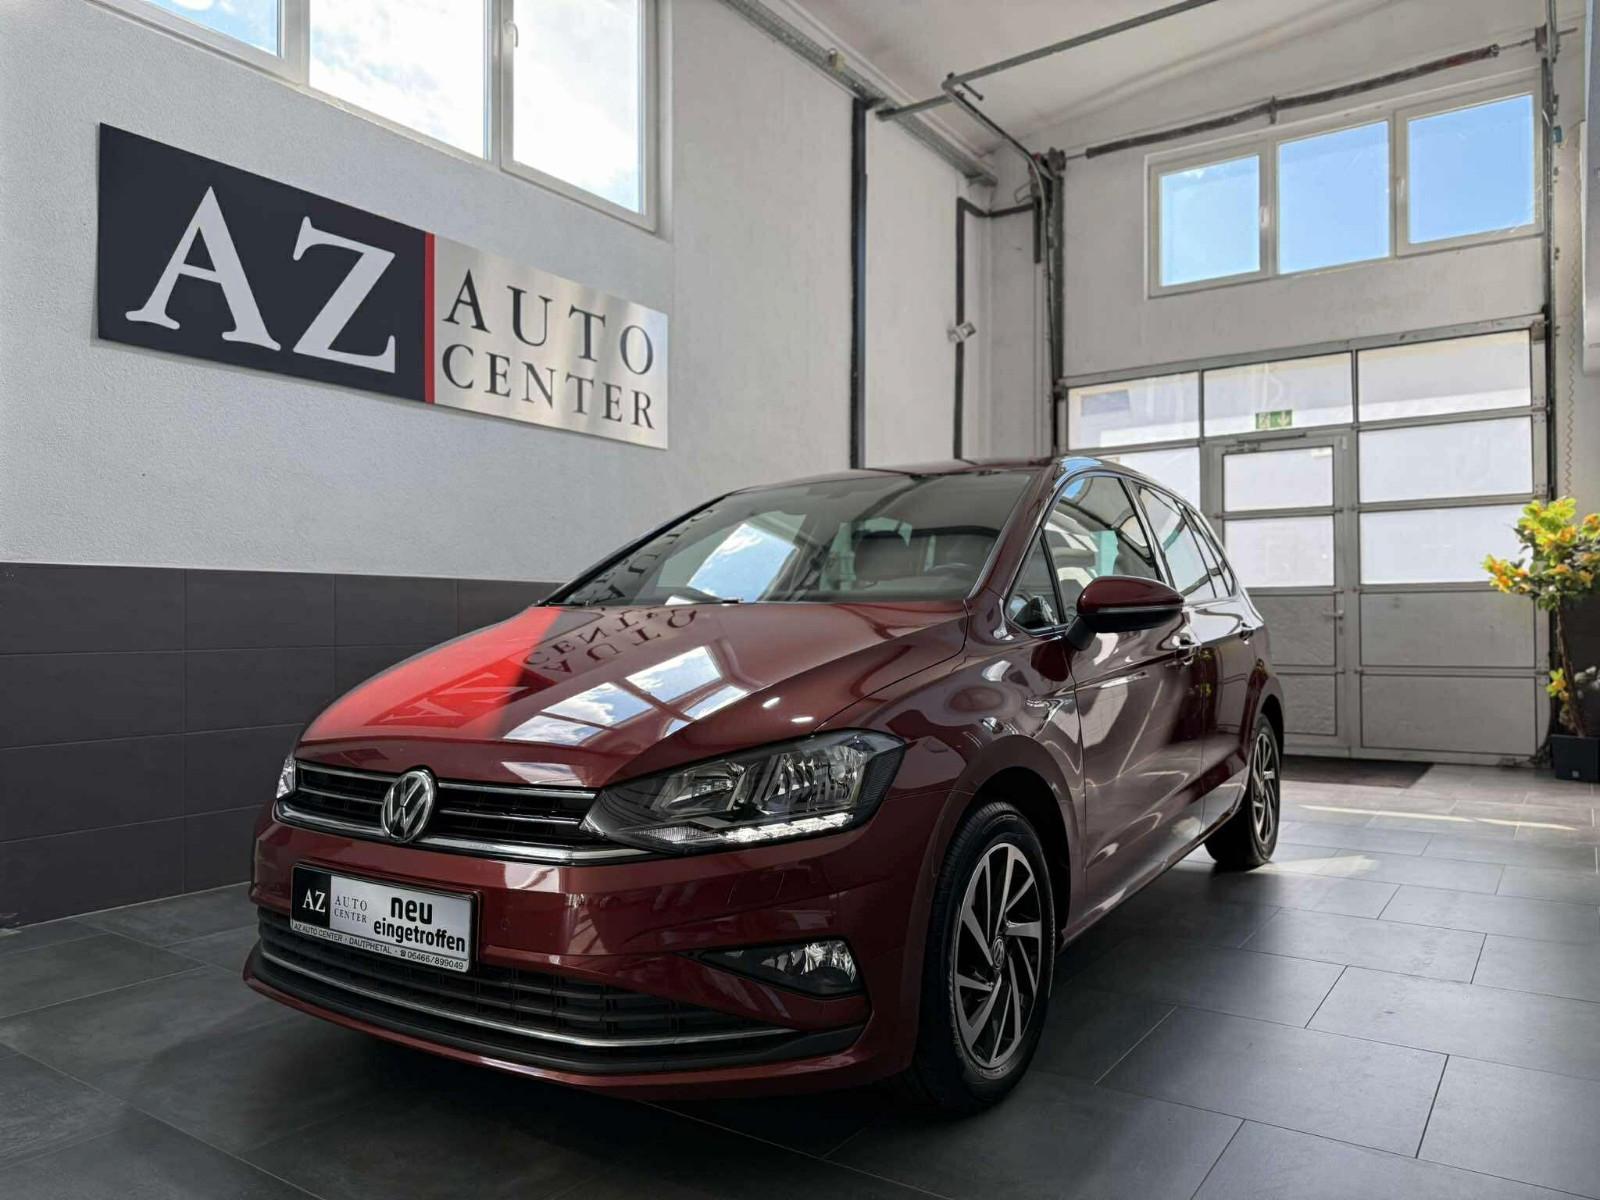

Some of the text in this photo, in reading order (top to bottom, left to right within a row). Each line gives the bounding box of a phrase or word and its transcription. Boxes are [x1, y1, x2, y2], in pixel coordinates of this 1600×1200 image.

[125, 186, 396, 374] AZ
[442, 269, 654, 376] AUTO
[442, 343, 656, 431] CENTER
[302, 888, 326, 913] AZ
[333, 907, 367, 924] CENTER
[334, 895, 368, 912] AUTO
[390, 897, 433, 925] neu
[303, 925, 318, 935] AUTO
[319, 929, 343, 942] CENTER
[349, 936, 392, 955] DAUTPHETAL
[373, 918, 466, 952] eingetroffen
